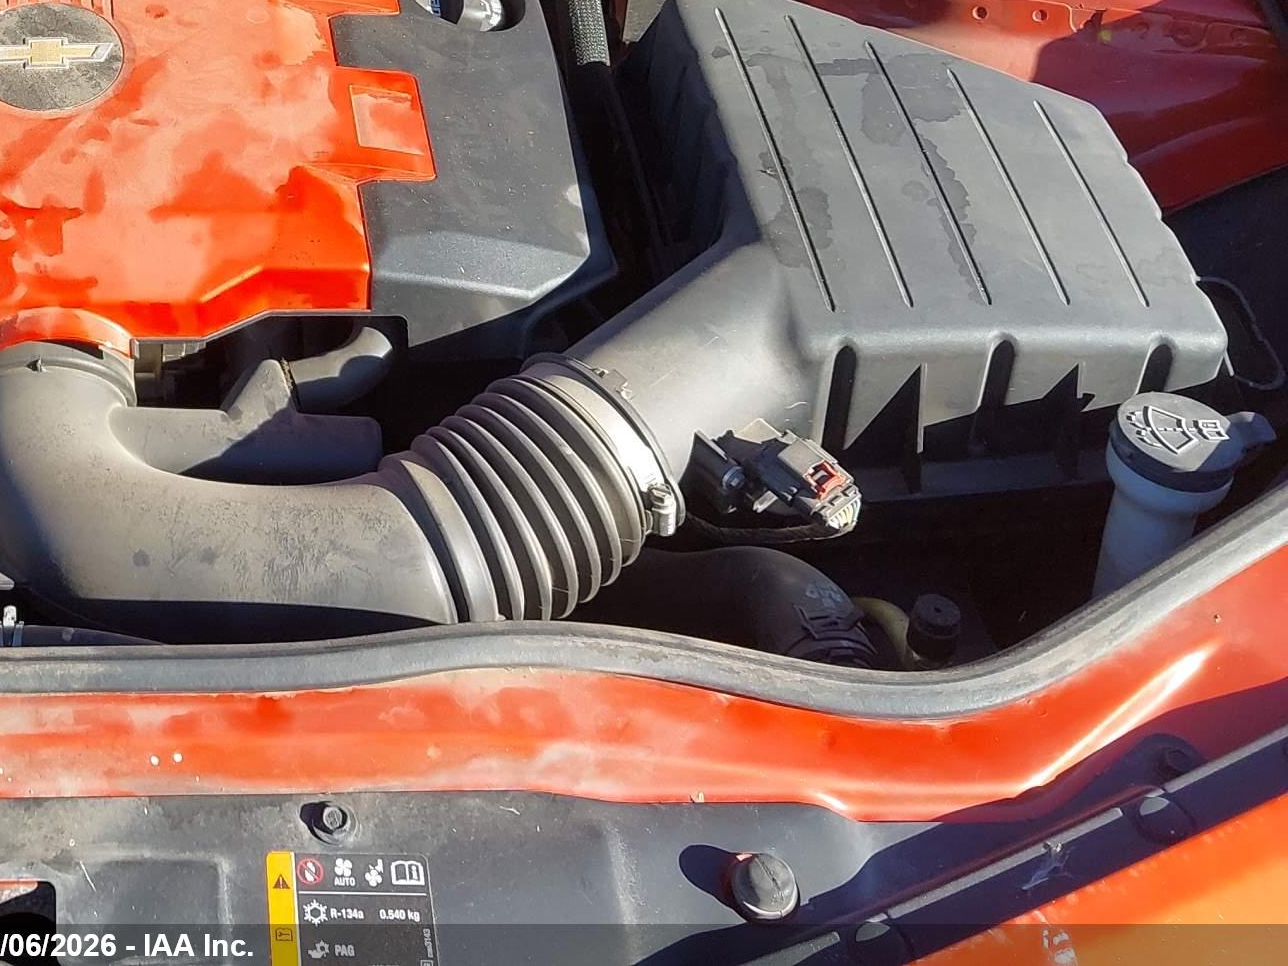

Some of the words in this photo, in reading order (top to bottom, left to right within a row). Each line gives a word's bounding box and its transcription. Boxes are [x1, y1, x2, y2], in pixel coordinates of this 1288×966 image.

[333, 876, 356, 887] AUTO
[330, 908, 364, 920] R-134a
[379, 909, 406, 920] 0.540
[407, 909, 421, 923] kg
[334, 944, 355, 958] PAG
